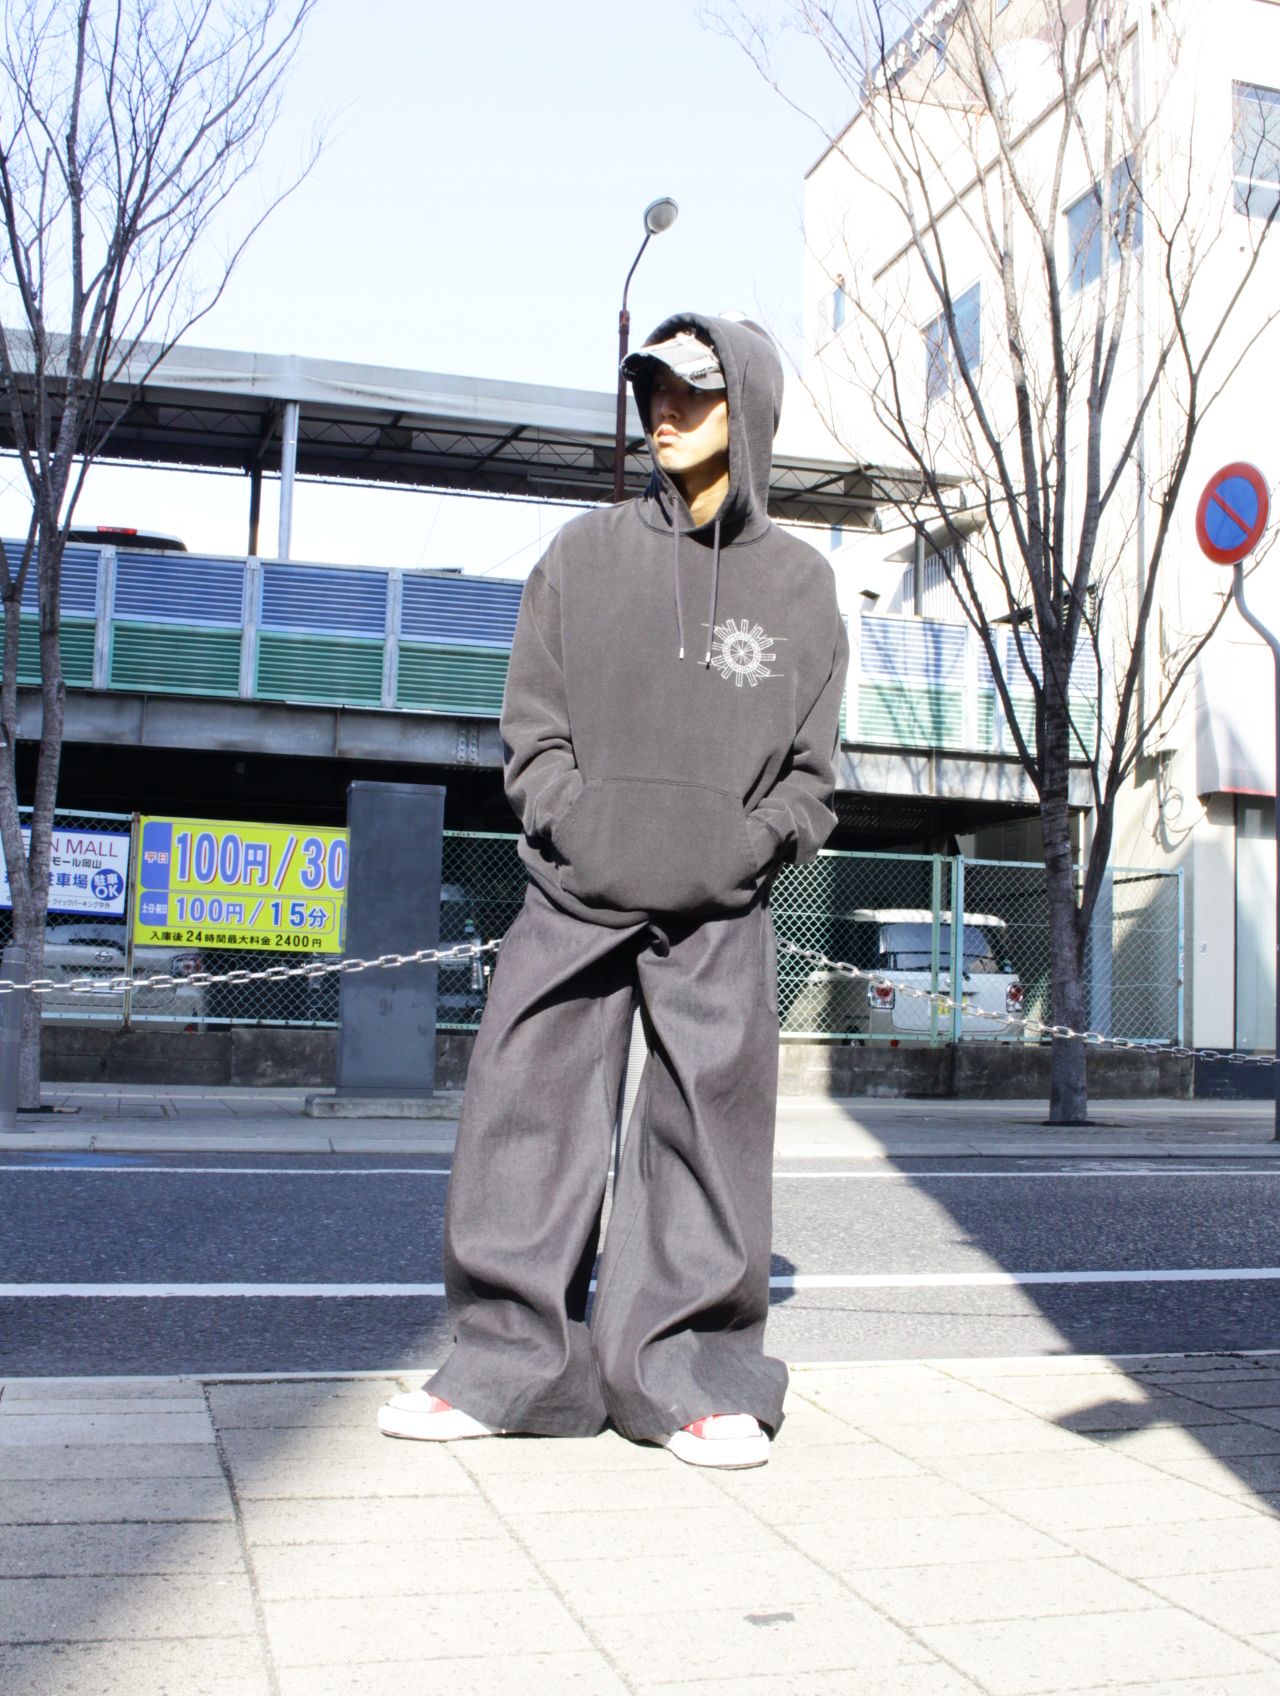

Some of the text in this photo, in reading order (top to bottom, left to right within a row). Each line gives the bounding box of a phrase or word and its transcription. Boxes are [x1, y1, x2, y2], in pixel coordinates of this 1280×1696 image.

[66, 839, 118, 857] MALL
[144, 851, 169, 864] 平日
[93, 873, 119, 887] 駐車
[95, 884, 120, 898] OK
